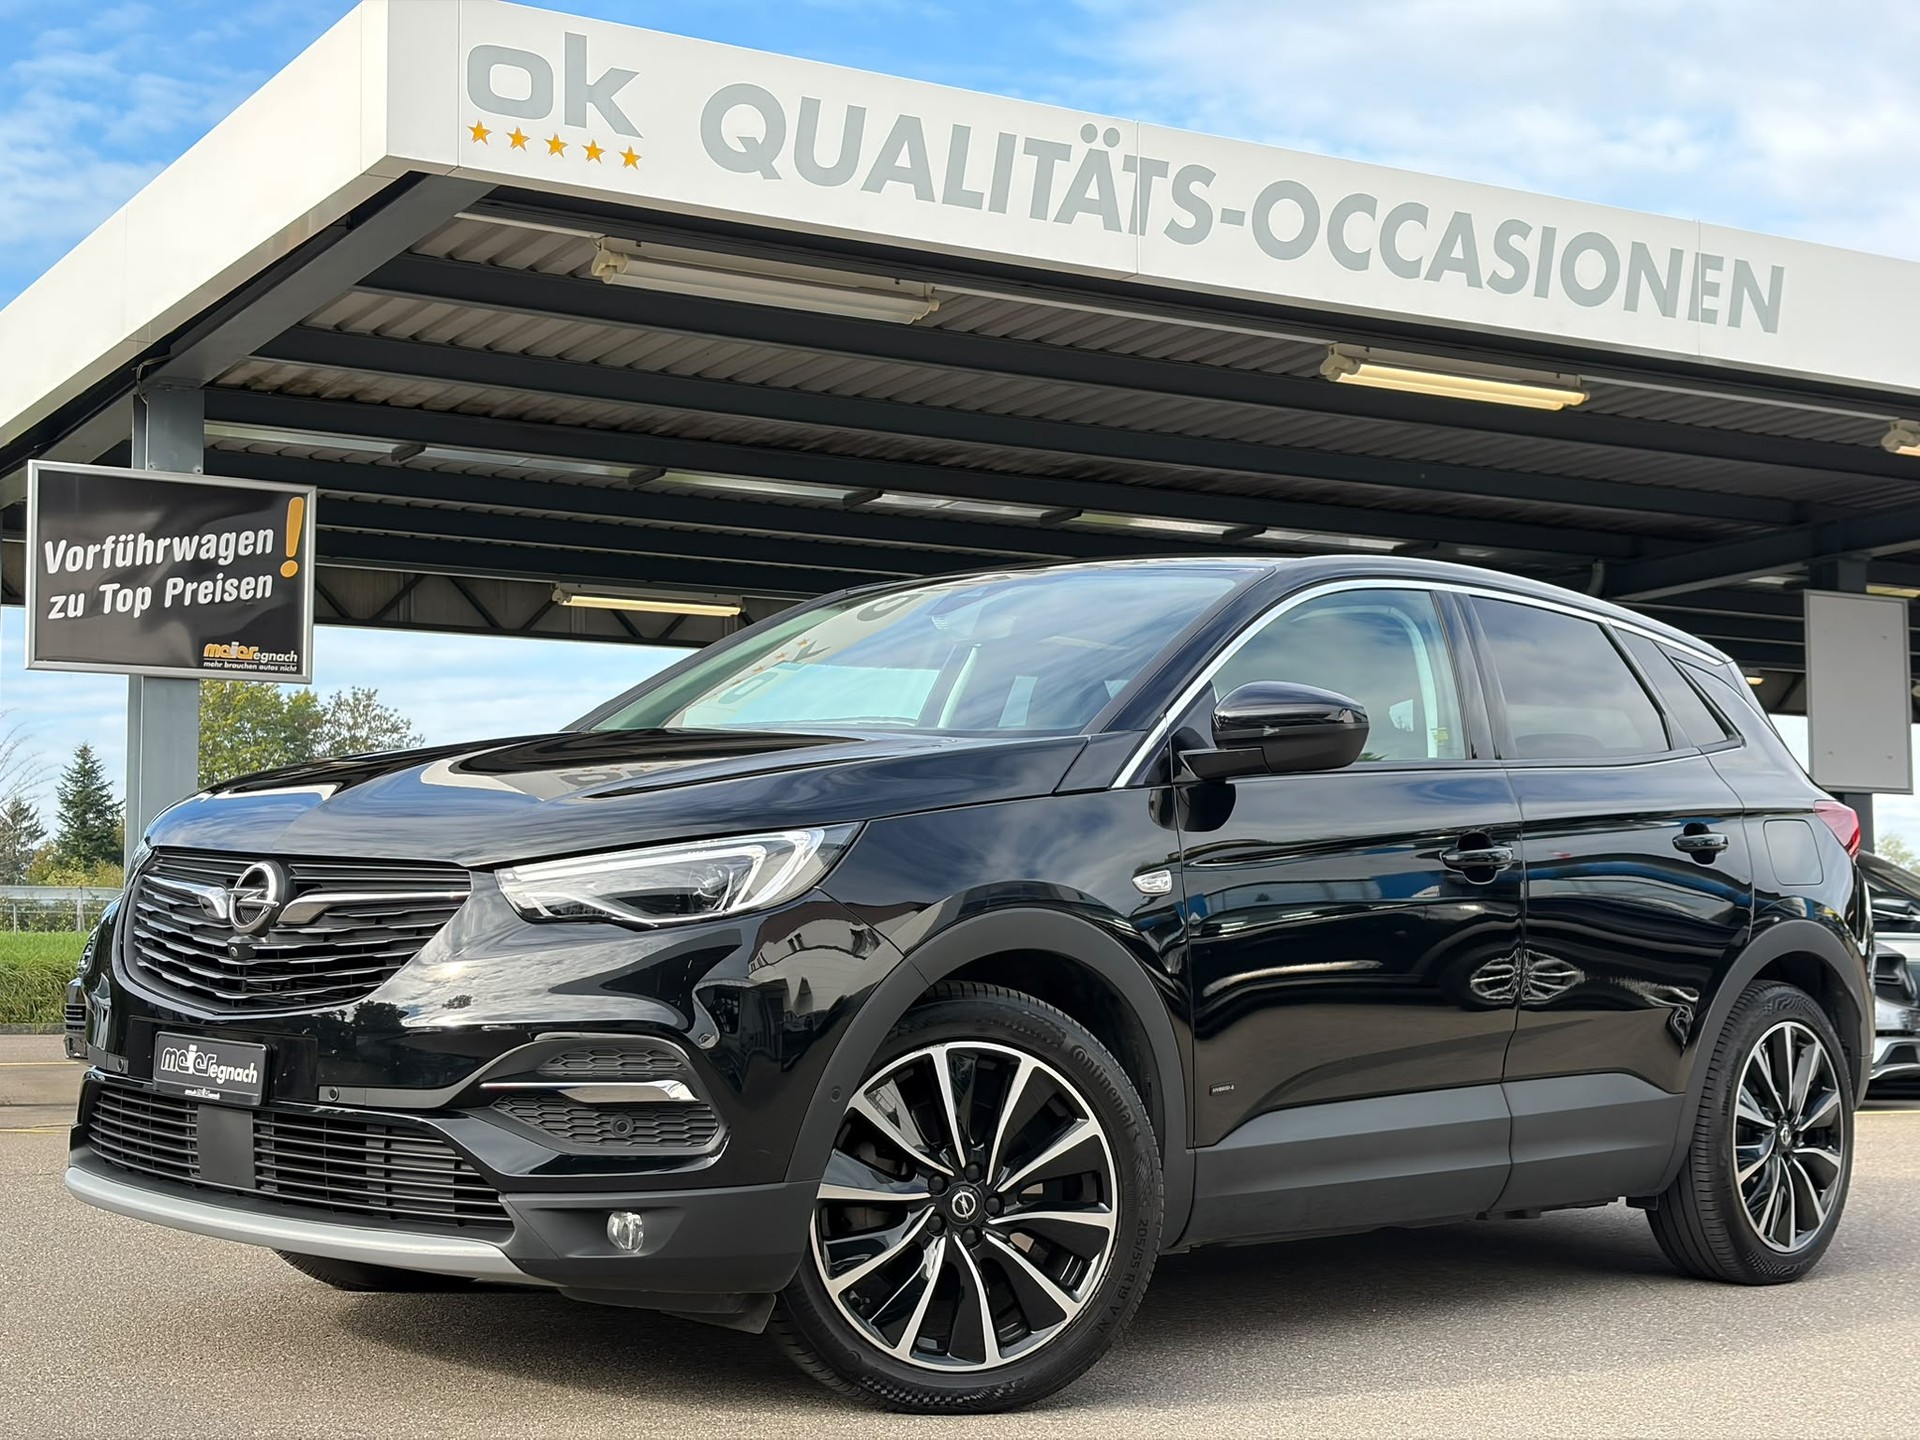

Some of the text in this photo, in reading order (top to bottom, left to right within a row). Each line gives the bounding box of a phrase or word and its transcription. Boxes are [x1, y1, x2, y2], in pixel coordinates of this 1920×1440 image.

[467, 32, 1785, 334] ok QUALITÄTS-OCCASIONEN
[44, 527, 274, 574] Vorführwagen
[47, 572, 273, 620] zu Top Preisen
[224, 661, 257, 670] brauchen
[280, 664, 297, 672] nicht
[1071, 1044, 1137, 1129] Continental
